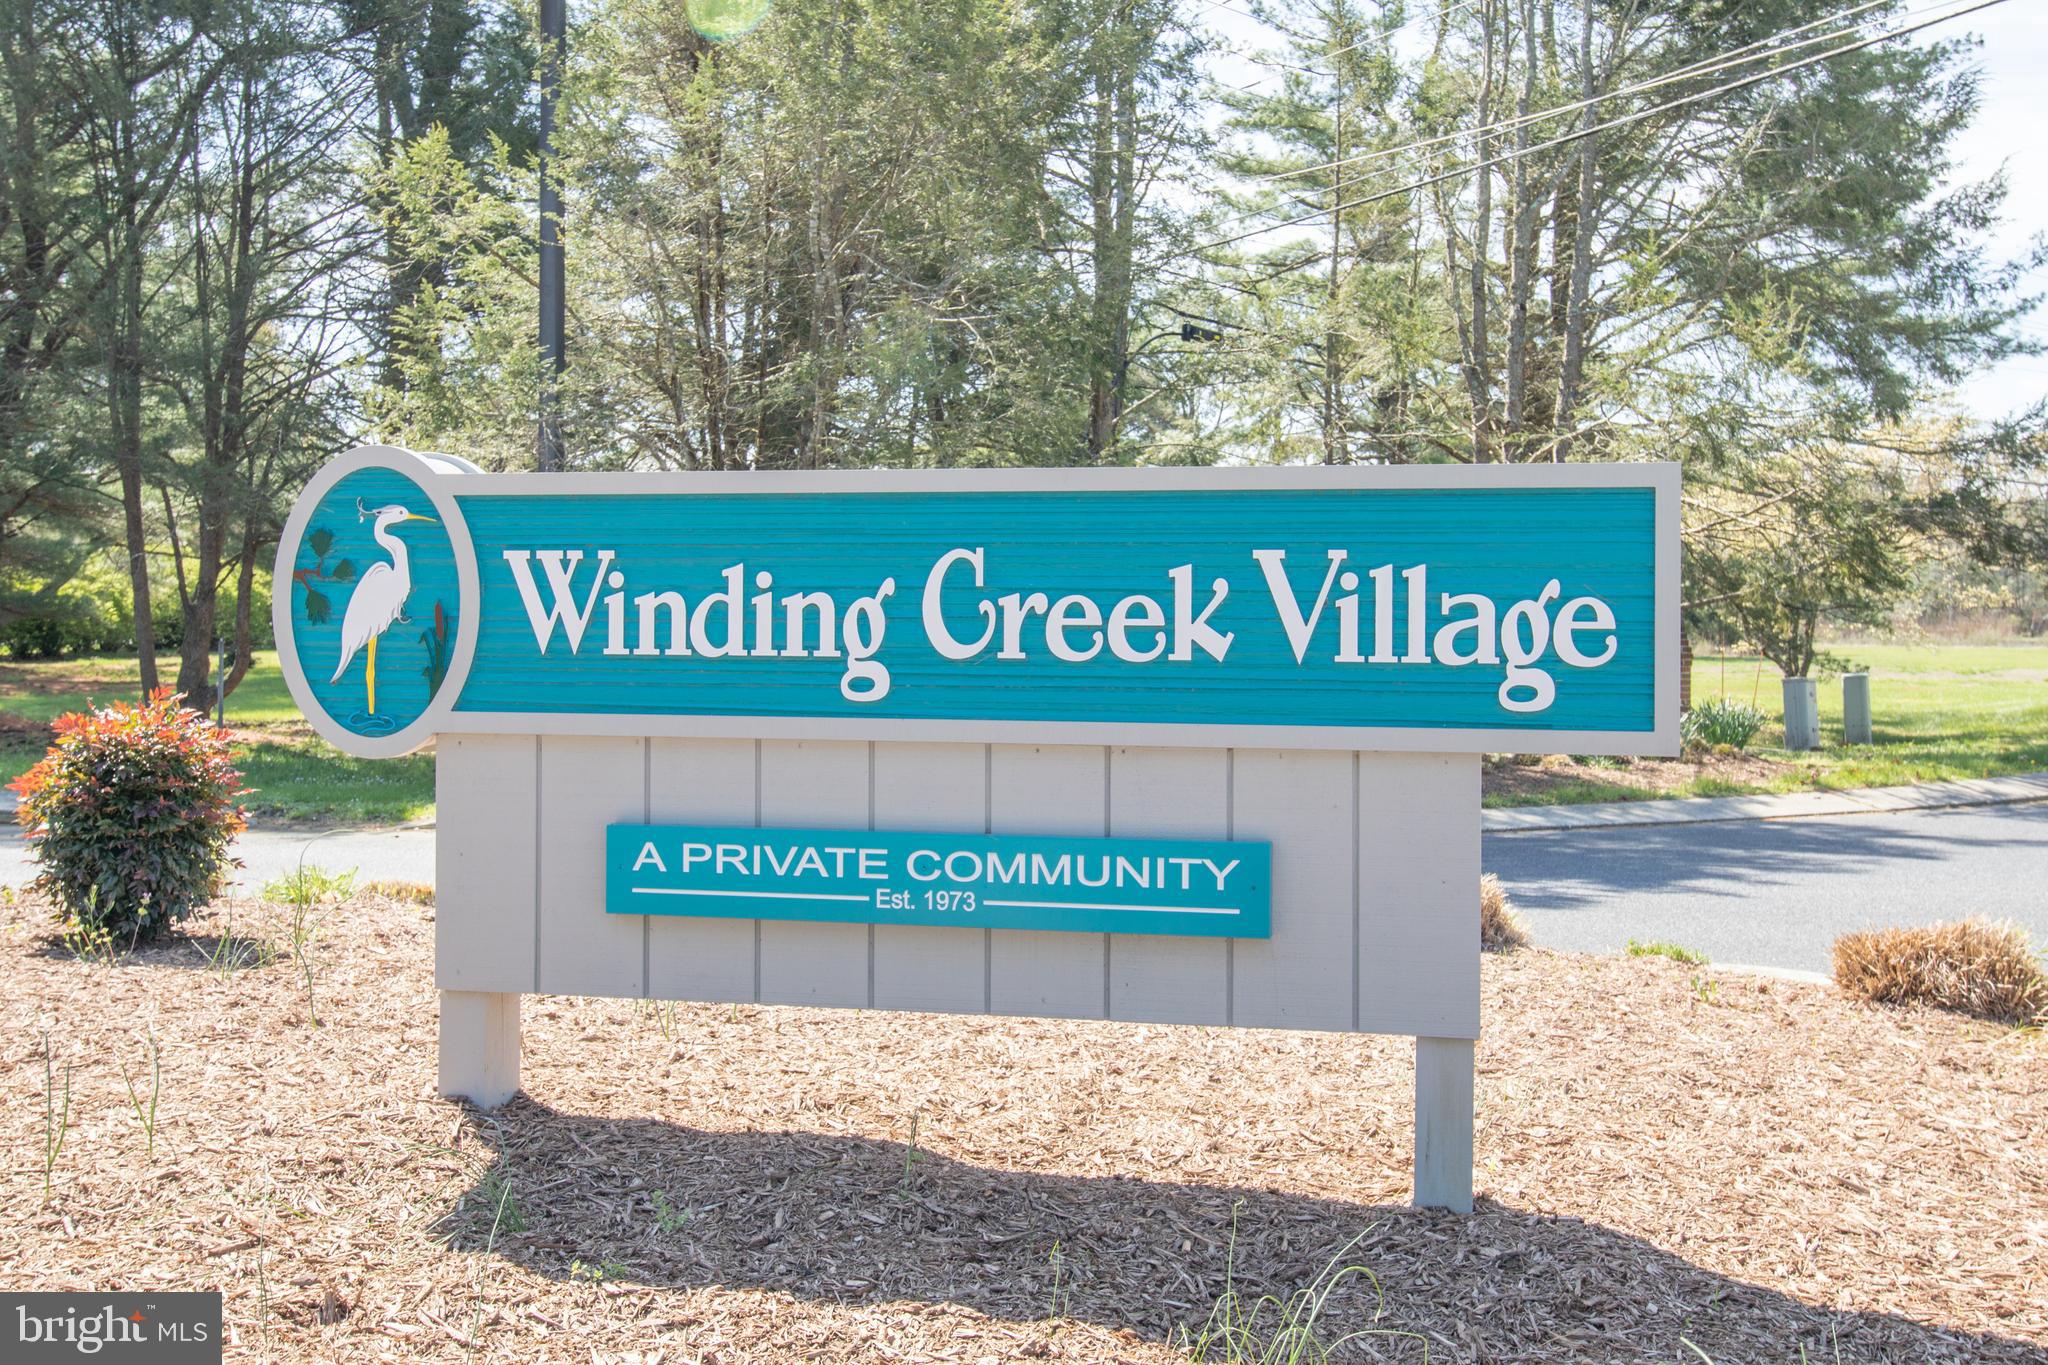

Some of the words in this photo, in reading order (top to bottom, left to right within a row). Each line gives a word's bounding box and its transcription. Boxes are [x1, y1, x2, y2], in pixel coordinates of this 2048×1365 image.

[503, 548, 895, 703] Winding
[922, 547, 1235, 663] Creek
[1252, 549, 1618, 712] Village
[632, 842, 667, 872] A
[682, 843, 889, 880] PRIVATE
[906, 849, 1240, 891] COMMUNITY
[876, 888, 916, 910] Est.
[924, 890, 976, 912] 1973
